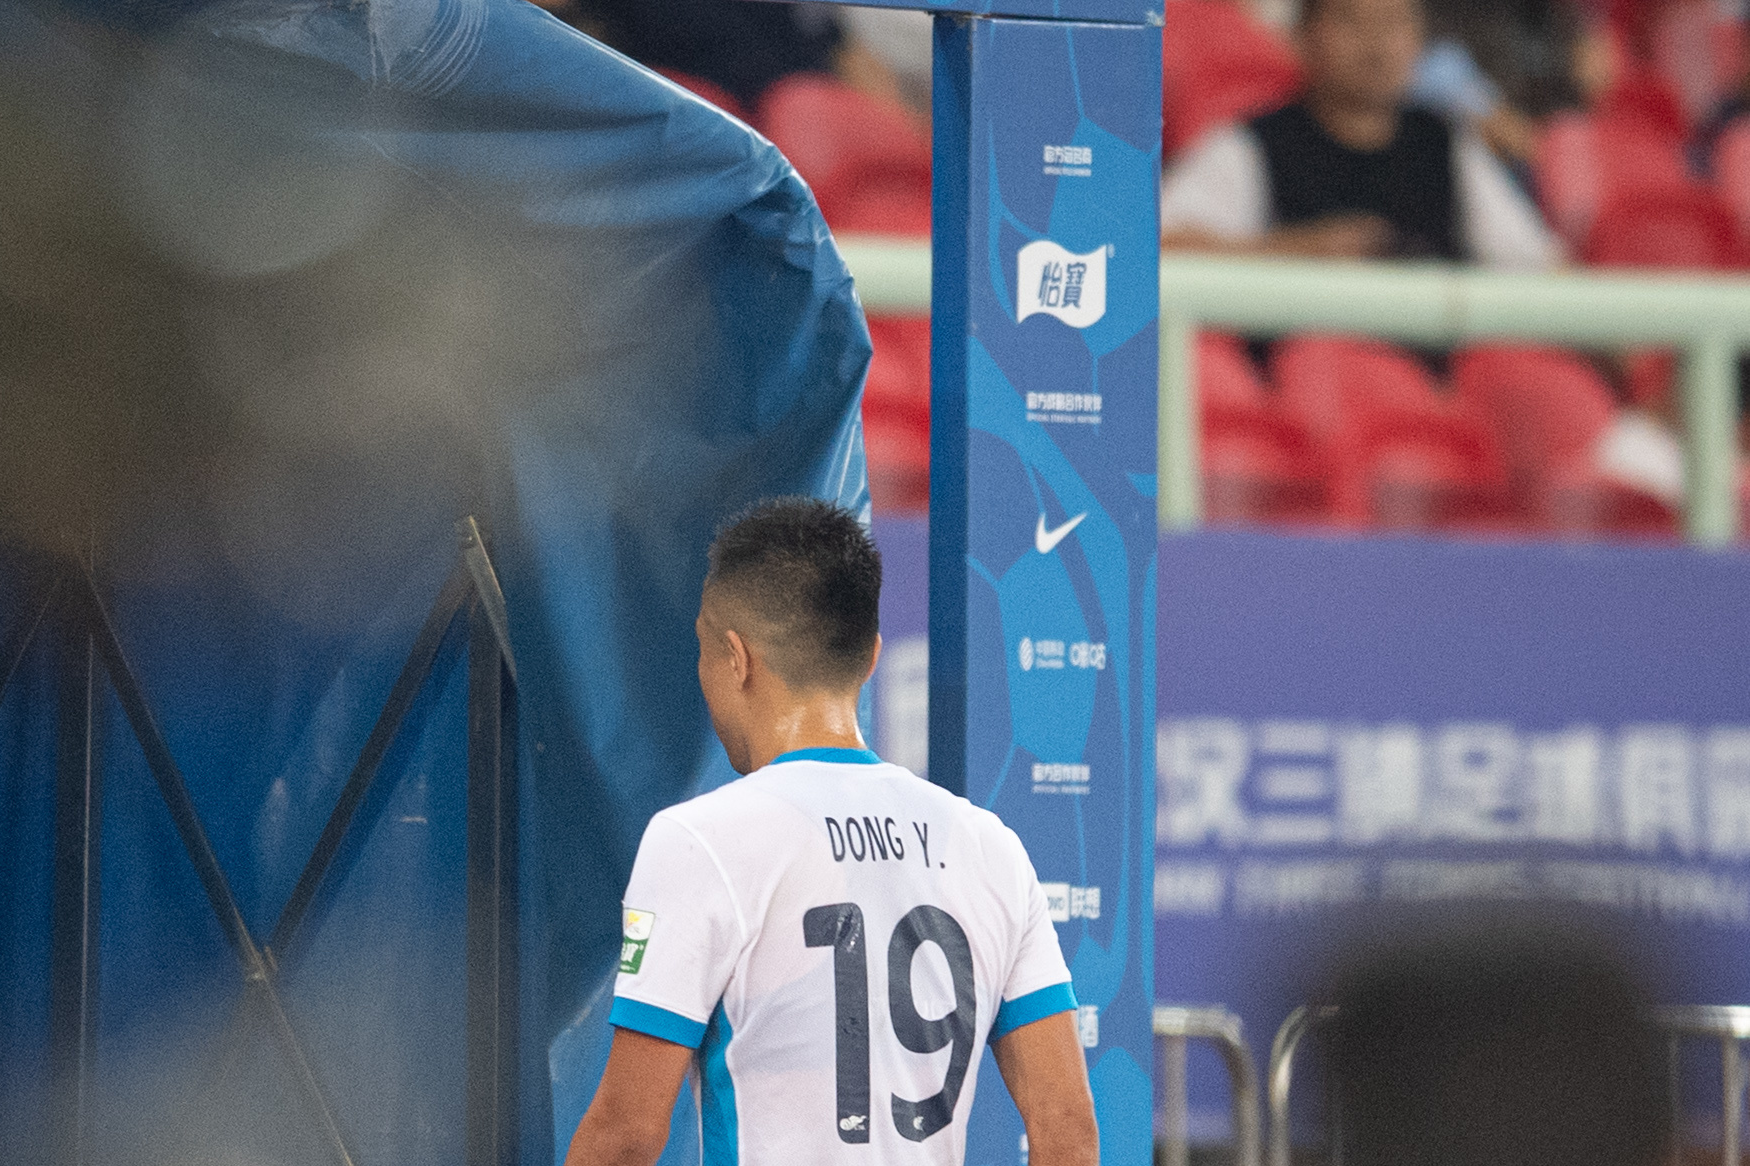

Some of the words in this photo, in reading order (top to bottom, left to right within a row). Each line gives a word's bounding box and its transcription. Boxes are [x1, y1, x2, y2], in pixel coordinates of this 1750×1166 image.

[825, 816, 905, 862] DONG
[912, 821, 946, 869] Y.
[803, 902, 976, 1144] 19
